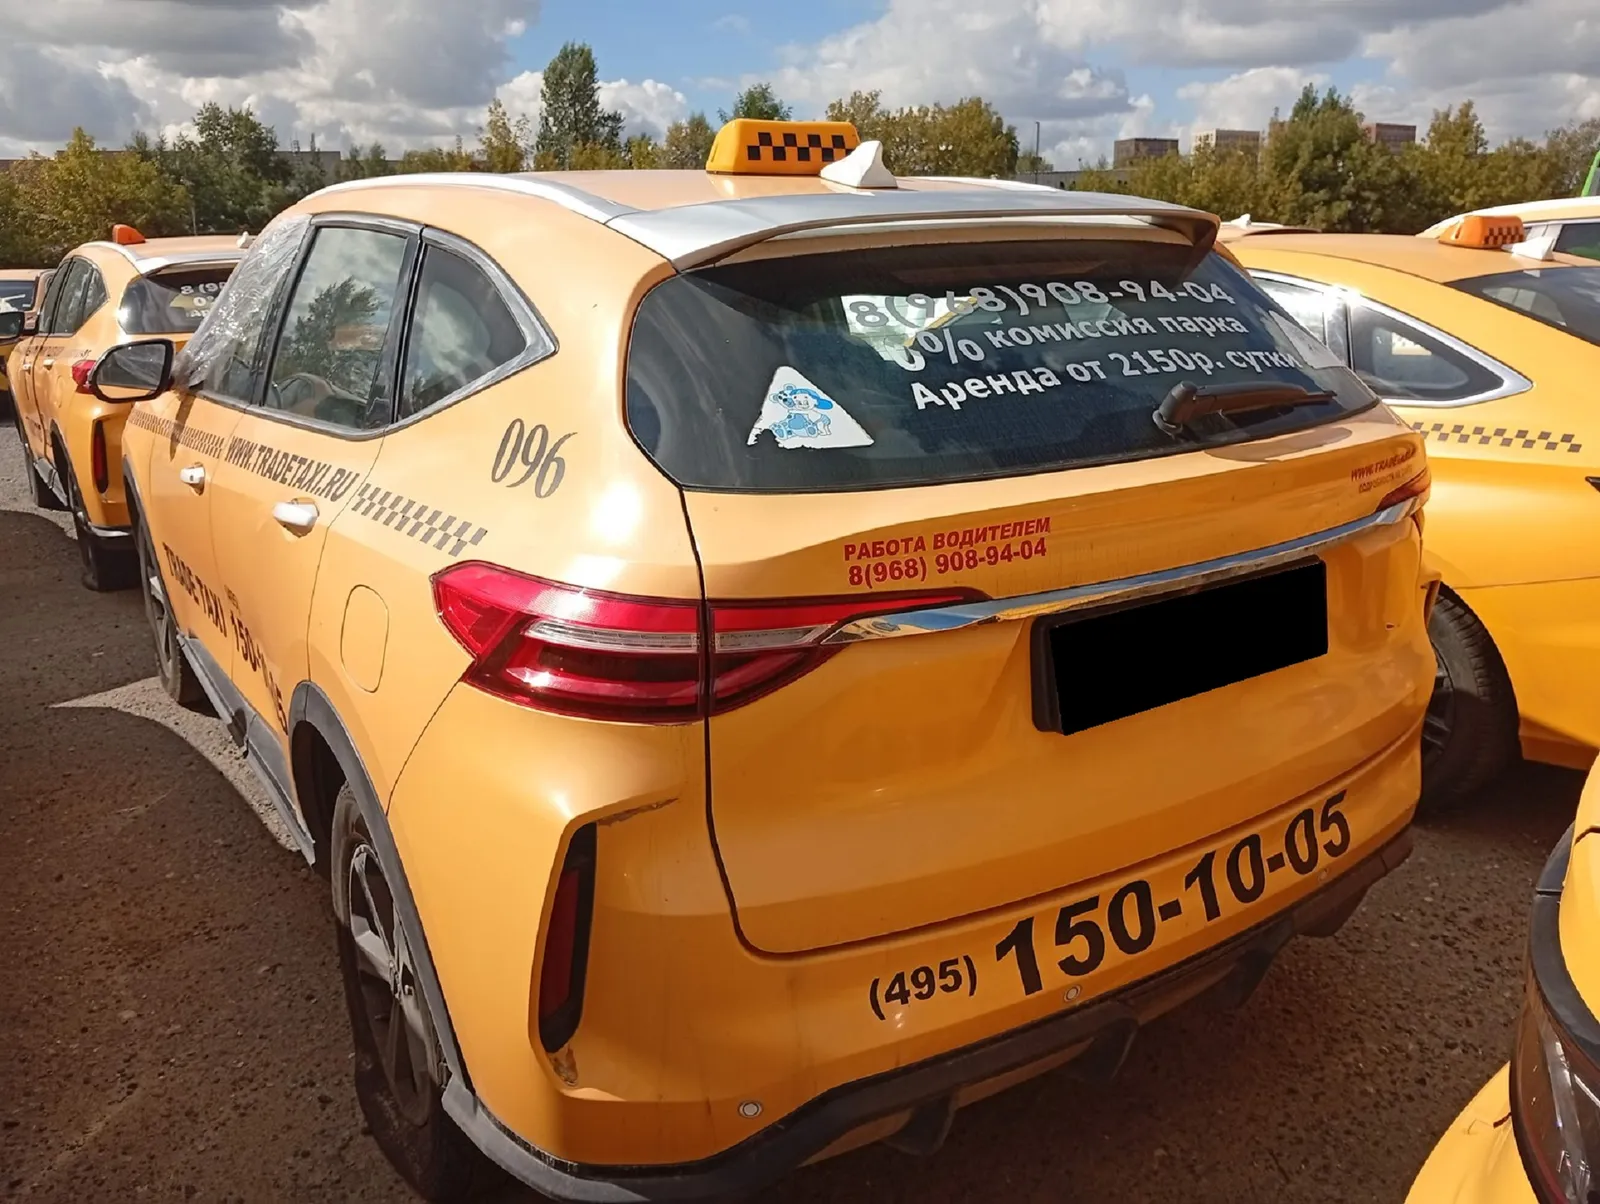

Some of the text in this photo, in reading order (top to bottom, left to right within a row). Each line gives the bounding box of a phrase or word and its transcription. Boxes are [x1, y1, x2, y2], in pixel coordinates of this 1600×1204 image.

[850, 279, 1236, 329] 8(968)908-94-04
[983, 315, 1158, 349] комиссия
[1161, 314, 1250, 341] парка
[910, 347, 1304, 410] Аренда от 2150р. сутки
[224, 435, 360, 502] WWW.TRADETAXI.RU
[490, 418, 578, 499] 096
[844, 517, 1051, 561] РАБОТА ВОДИТЕЛЕМ
[849, 537, 1047, 588] 8(968) 908-94-04
[868, 788, 1351, 1021] (495) 150-10-05
